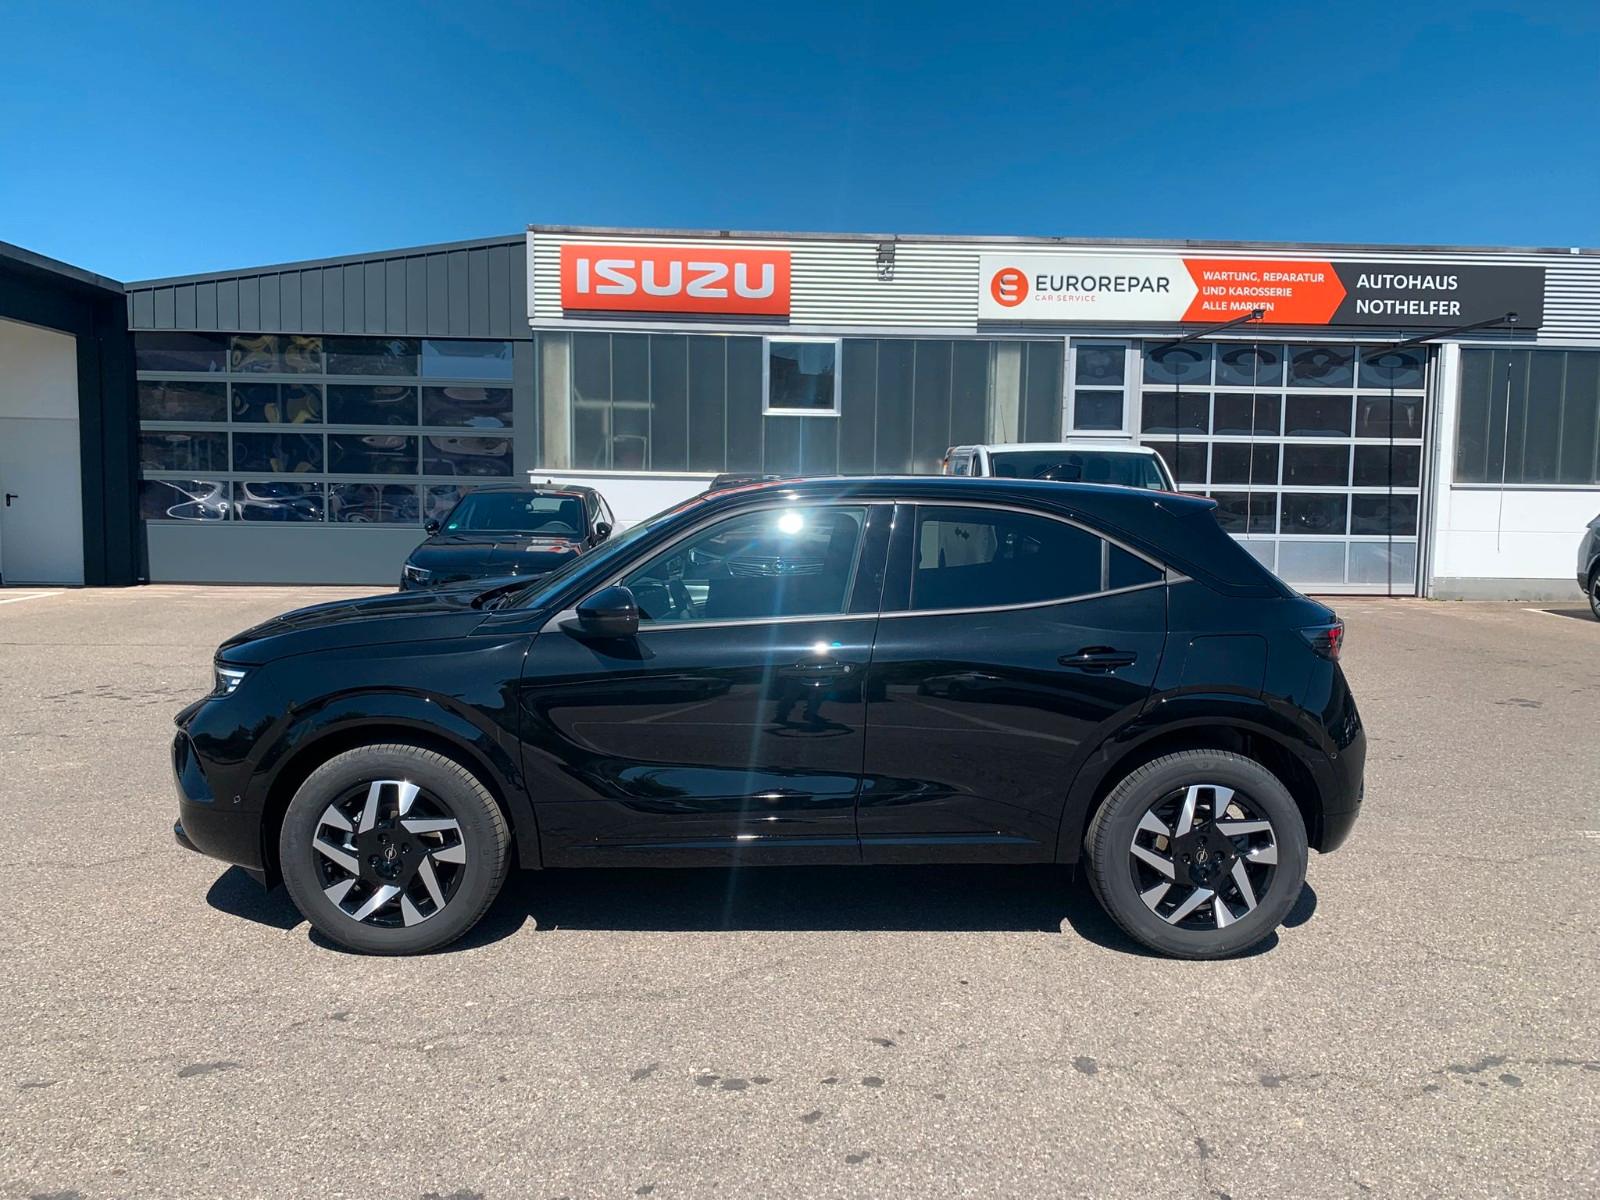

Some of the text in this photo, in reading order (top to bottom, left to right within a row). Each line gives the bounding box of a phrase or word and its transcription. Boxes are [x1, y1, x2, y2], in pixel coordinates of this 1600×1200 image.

[576, 258, 775, 299] ISUZU
[1035, 275, 1170, 293] EUROREPAR
[1203, 271, 1325, 283] WARTUNG, REPARATUR
[1356, 274, 1458, 290] AUTOHAUS
[1035, 294, 1096, 302] CAR SERVICE
[1202, 286, 1293, 297] UND KAROSSERIE
[1202, 301, 1227, 311] ALLE
[1356, 299, 1461, 316] NOTHELFER
